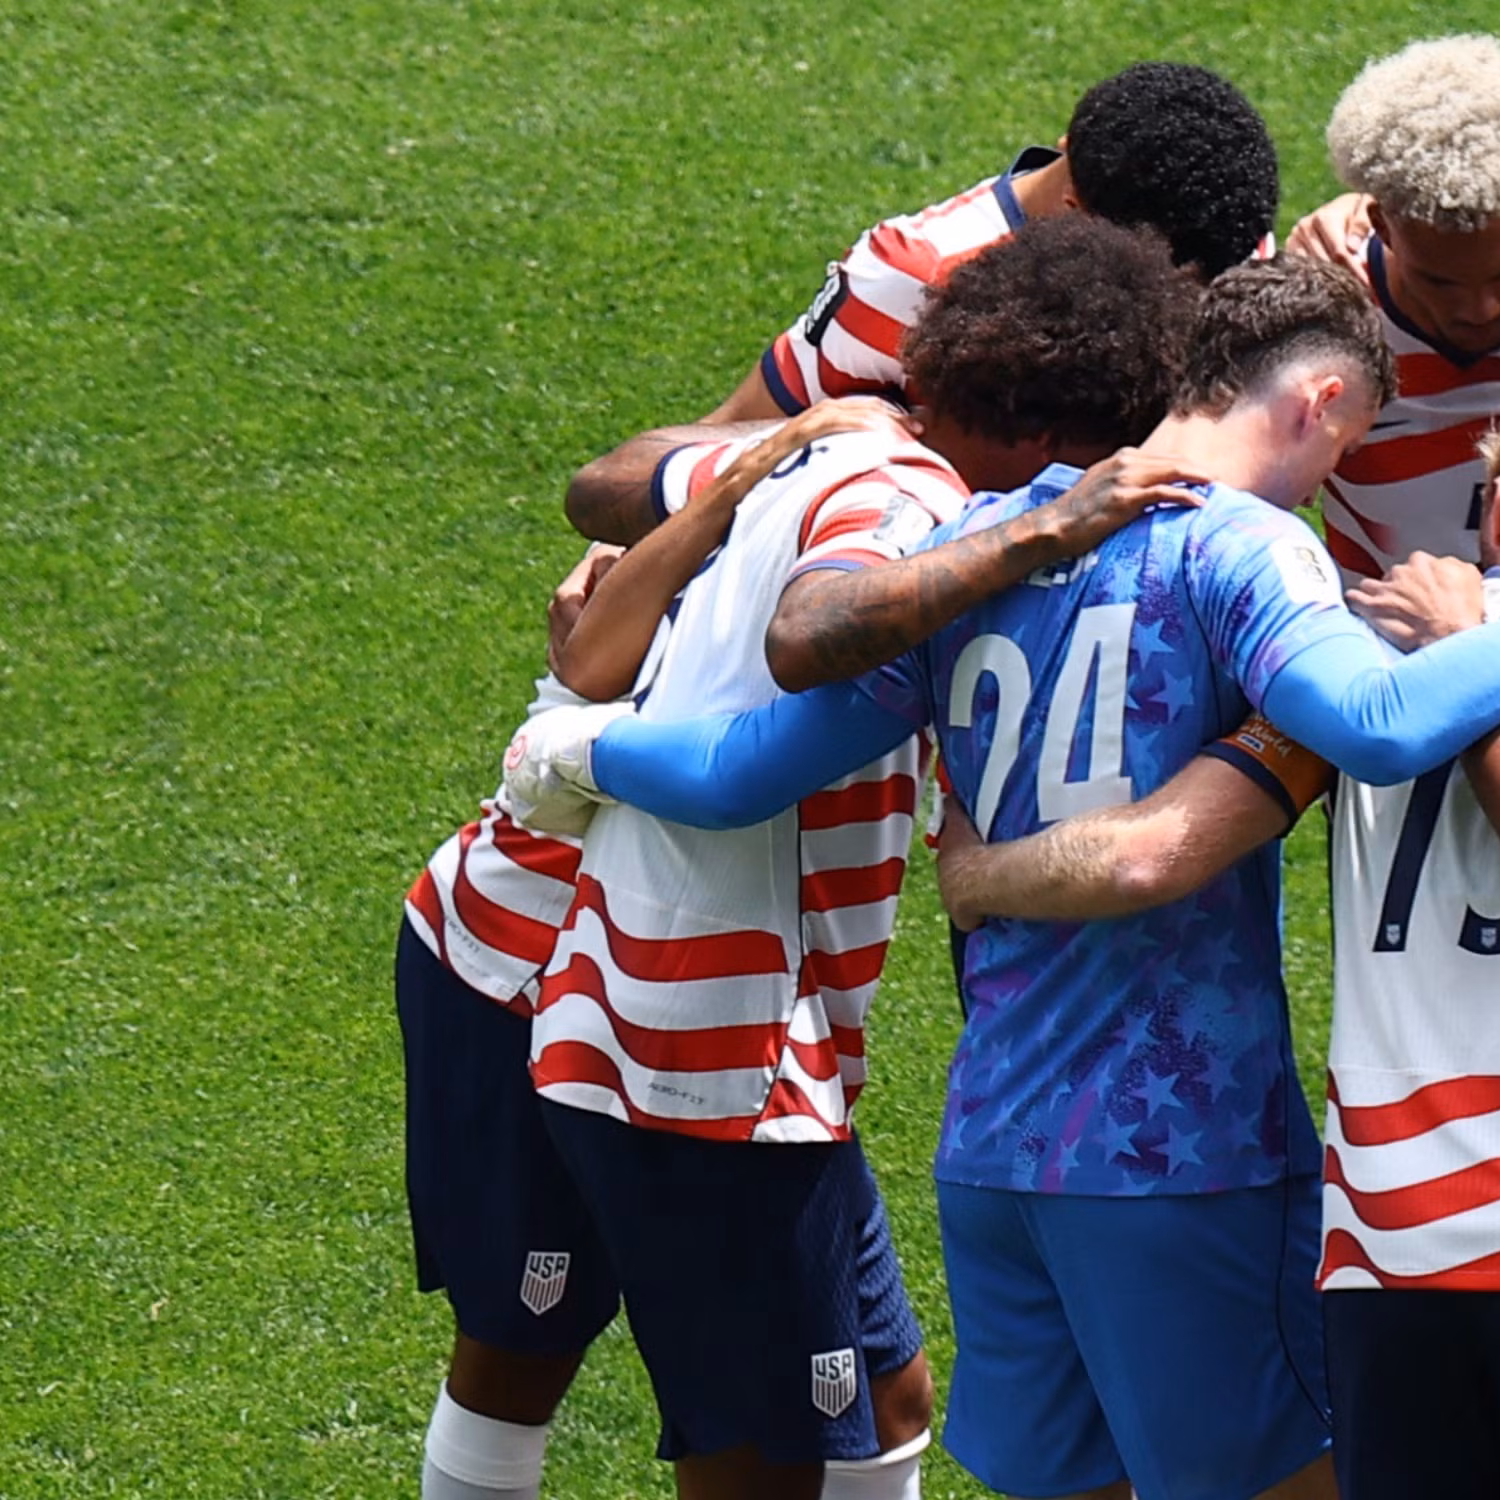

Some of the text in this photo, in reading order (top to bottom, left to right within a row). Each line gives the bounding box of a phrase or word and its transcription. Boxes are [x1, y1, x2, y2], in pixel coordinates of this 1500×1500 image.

[948, 602, 1137, 843] 24
[529, 1254, 567, 1279] USA
[815, 1353, 851, 1381] USA
